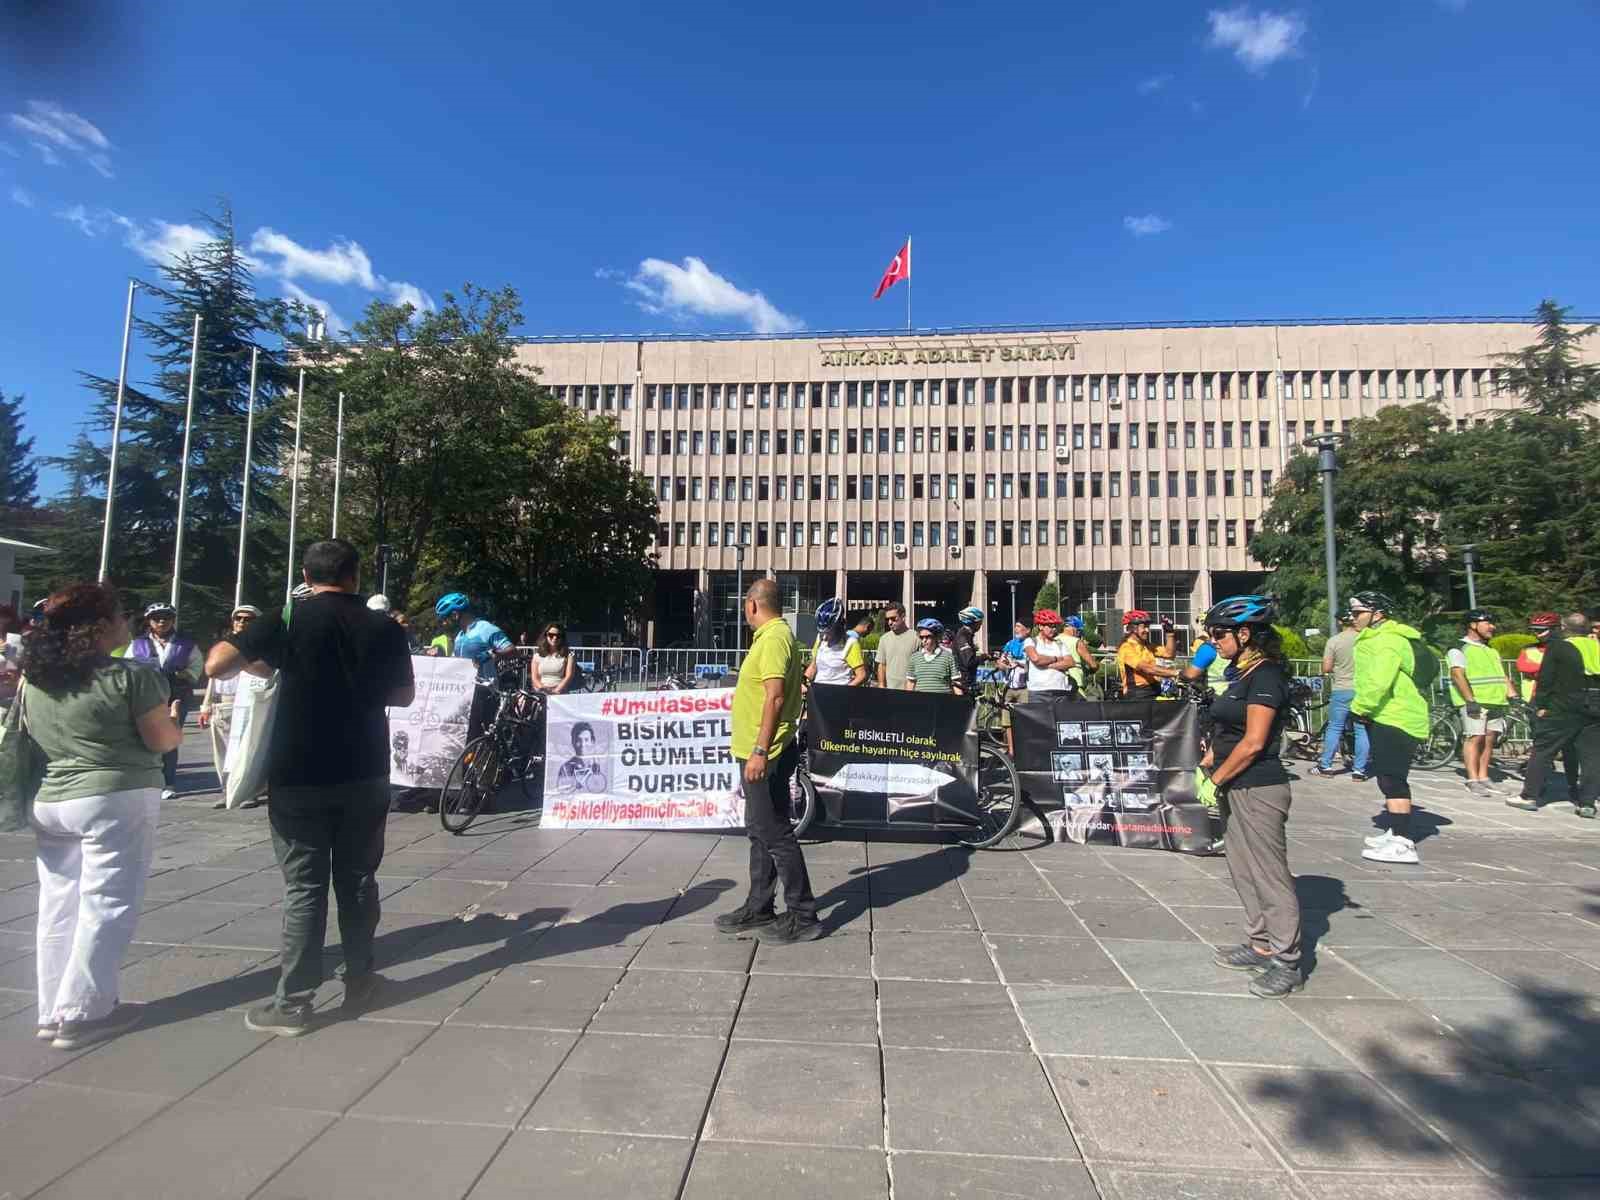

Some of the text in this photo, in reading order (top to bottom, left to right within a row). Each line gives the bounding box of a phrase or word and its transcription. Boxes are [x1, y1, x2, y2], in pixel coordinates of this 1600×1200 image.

[821, 344, 1076, 366] ANKARA ADALET SARAYI
[602, 694, 734, 716] #UmutaSesO
[617, 717, 732, 740] BİSİKLETL
[844, 730, 857, 739] Bir
[858, 730, 904, 743] BİSİKLETLİ
[621, 743, 733, 766] ÖLÜMLER
[862, 744, 898, 756] hayatım
[900, 747, 919, 758] hiçe
